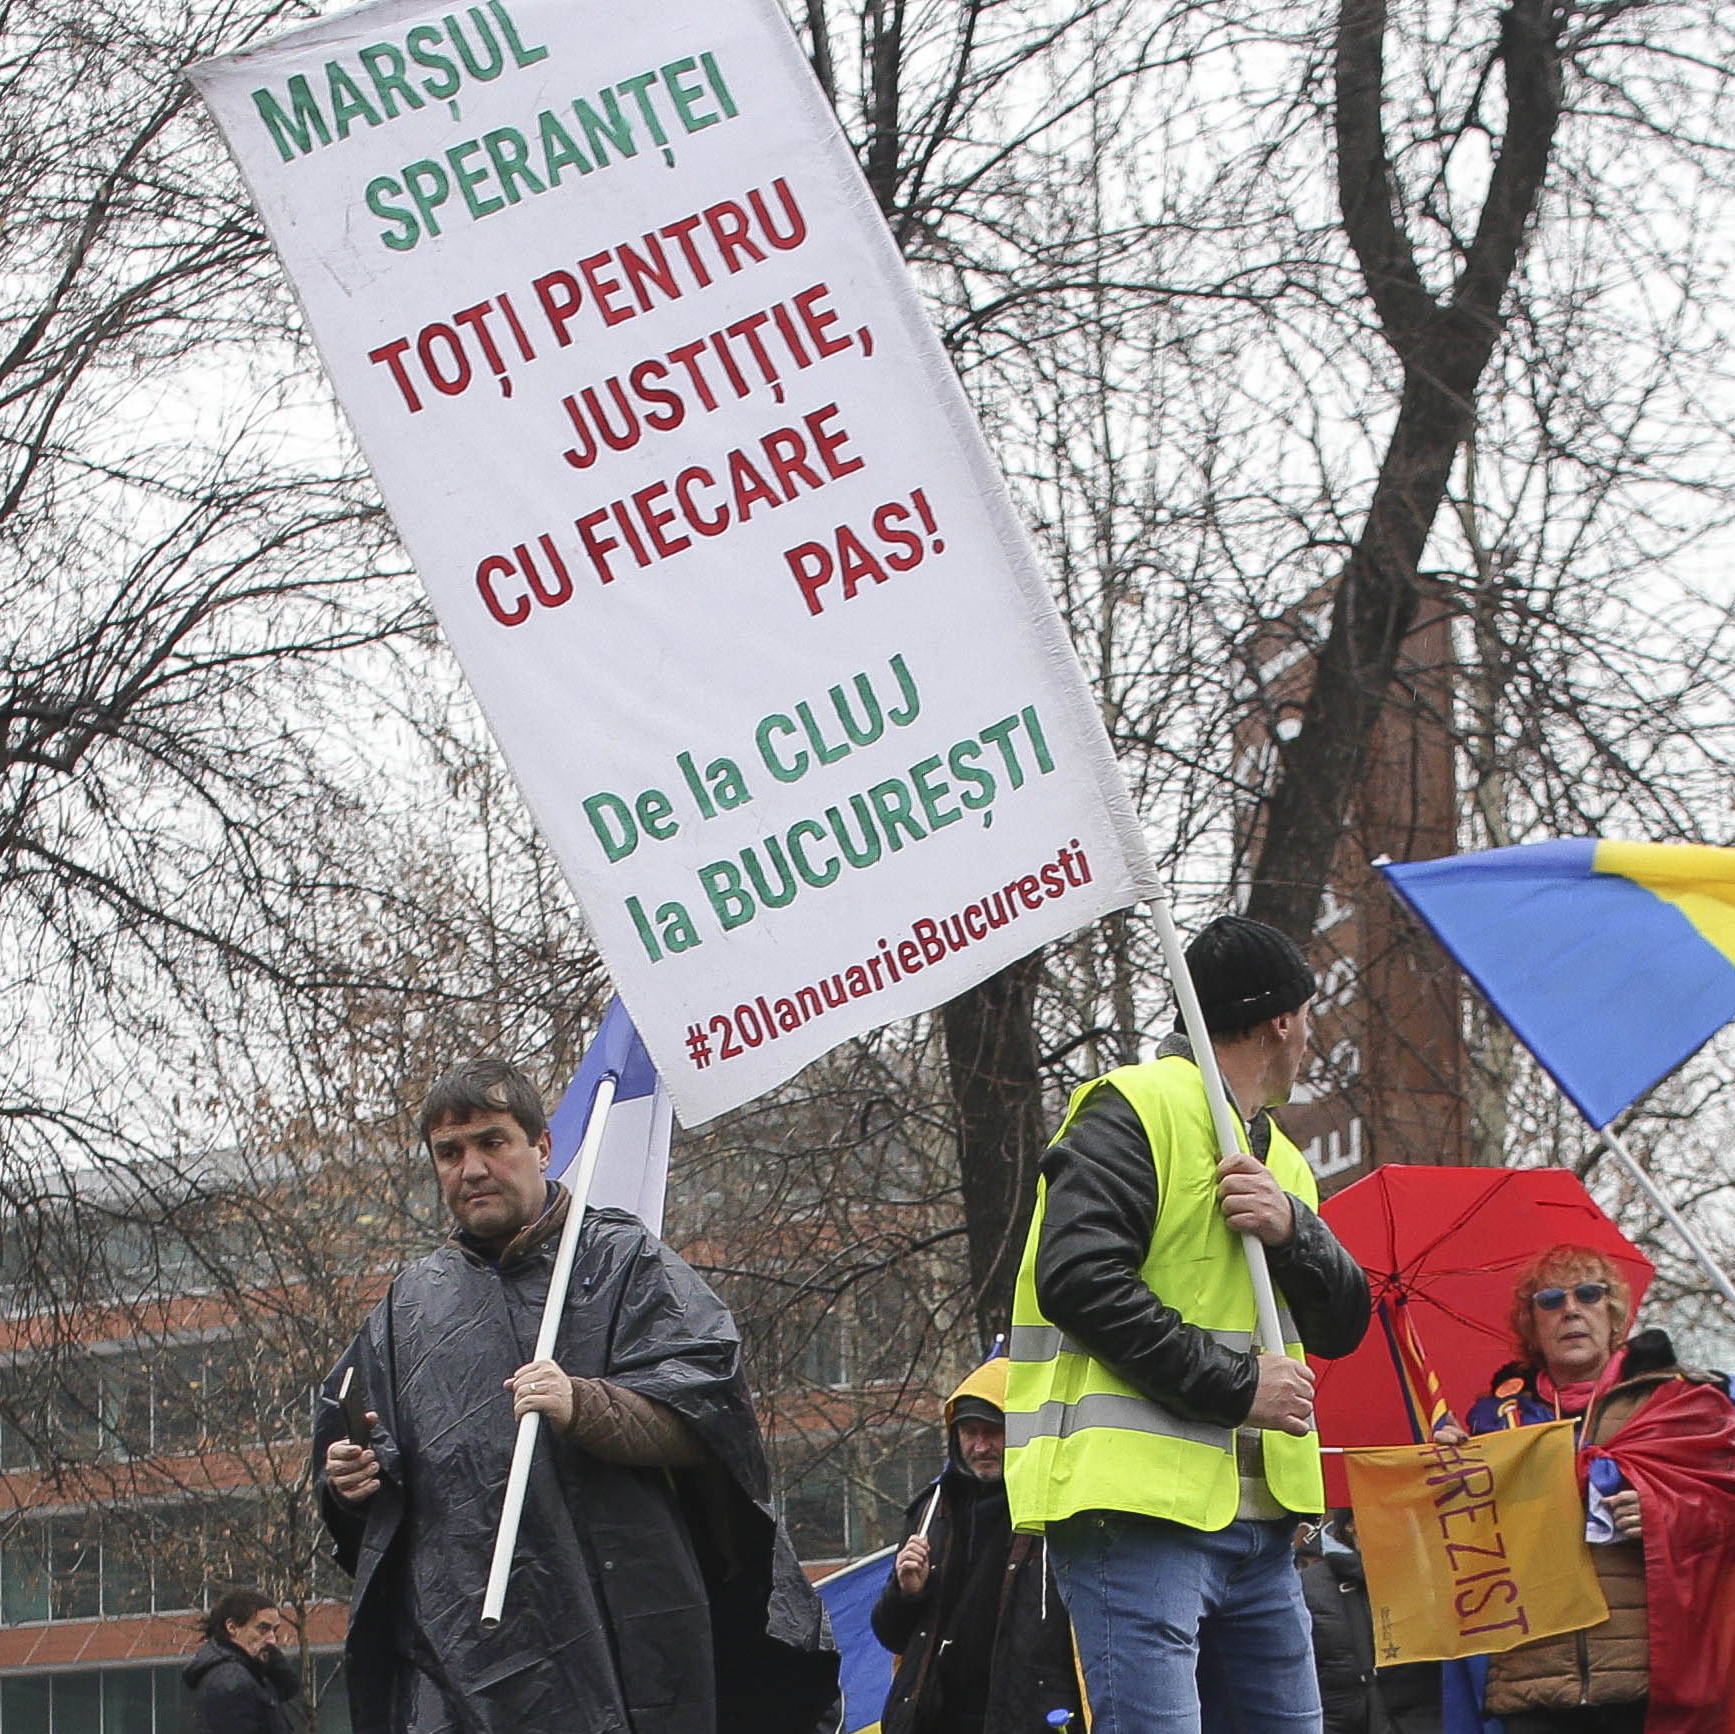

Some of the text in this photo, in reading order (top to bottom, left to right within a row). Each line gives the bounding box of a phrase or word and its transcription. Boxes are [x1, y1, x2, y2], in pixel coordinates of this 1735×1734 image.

[252, 1, 547, 162] MARȘUL
[366, 52, 738, 250] SPERANȚEI
[369, 178, 807, 413] TOȚI PENTRU
[563, 283, 873, 469] JUSTIȚIE,
[477, 403, 865, 628] CU FIECARE
[784, 488, 945, 616] PAS!
[583, 653, 920, 862] De la CLUJ
[627, 705, 1055, 962] la BUCUREȘTI
[686, 839, 1092, 1070] #20IanuarieBucuresti
[1418, 1445, 1529, 1637] #REZIST
